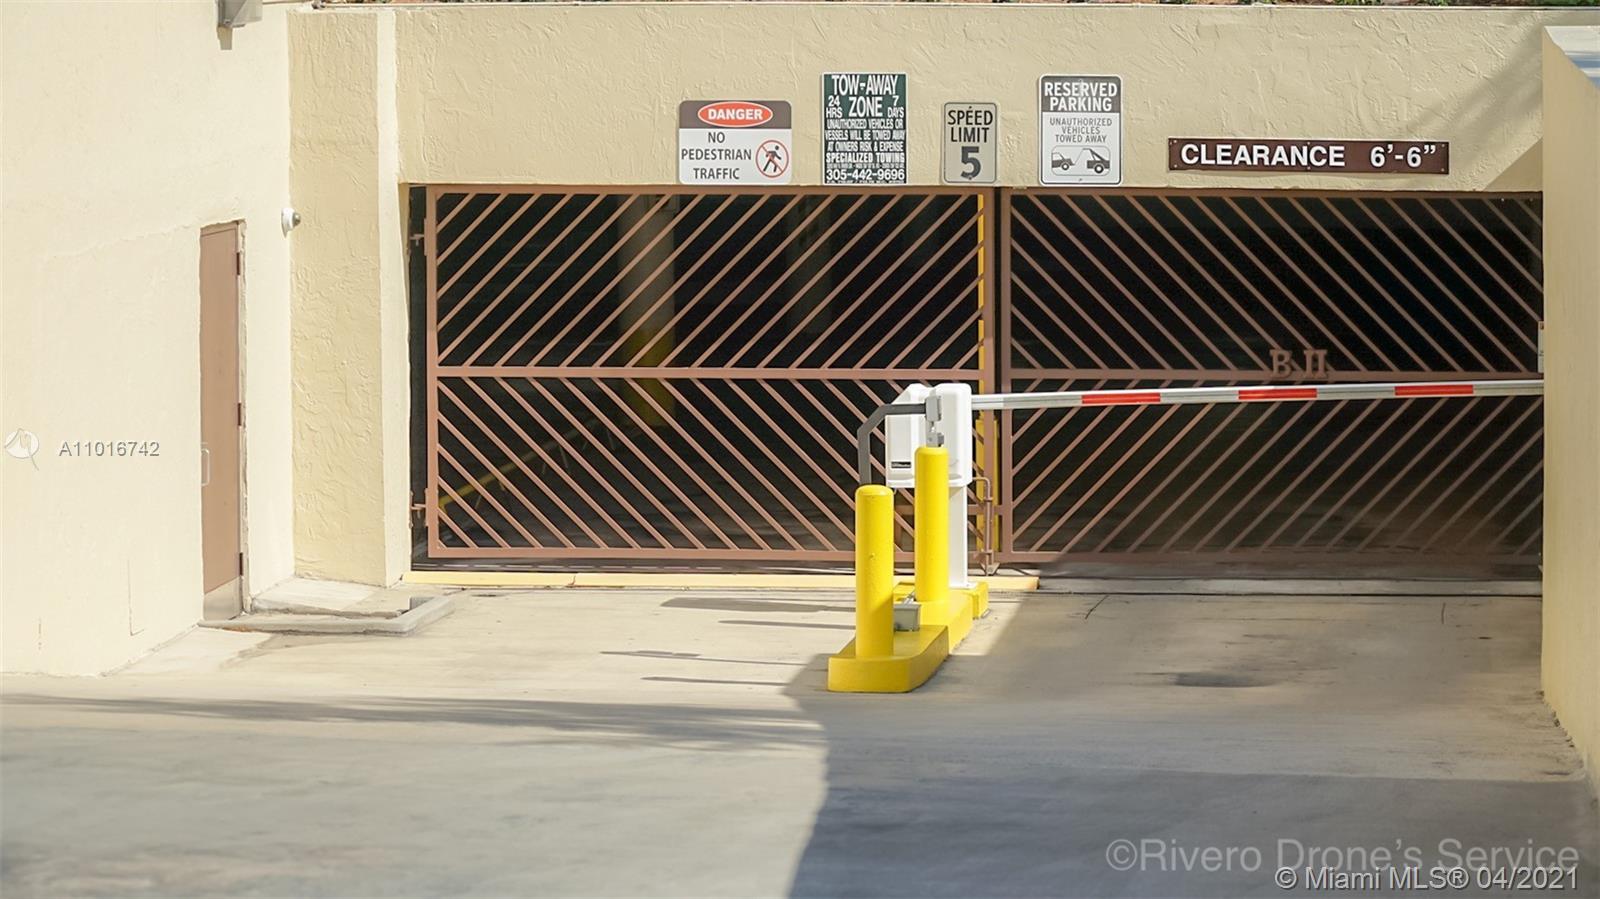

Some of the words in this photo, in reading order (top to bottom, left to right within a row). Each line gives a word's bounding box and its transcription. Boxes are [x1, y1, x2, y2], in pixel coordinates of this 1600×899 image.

[831, 74, 899, 96] TOW-AWAY
[1044, 82, 1118, 97] RESERVED
[828, 95, 841, 107] 24
[848, 96, 883, 118] ZONE
[892, 95, 900, 107] 7
[1049, 96, 1113, 112] PARKING
[707, 108, 763, 120] DANGER
[825, 106, 843, 119] HRS
[887, 106, 905, 119] DAYS
[947, 109, 994, 126] SPEED
[826, 118, 867, 130] UNAUTHORIZED
[868, 118, 894, 130] VEHICLES
[894, 118, 904, 130] OR
[1049, 117, 1113, 127] UNAUTHORIZED
[825, 129, 849, 141] VESSELS
[849, 129, 862, 141] WILL
[863, 129, 872, 141] BE
[872, 129, 891, 141] TOWED
[892, 129, 906, 141] AWAY
[950, 127, 990, 143] LIMIT
[1061, 126, 1101, 135] VEHICLES
[707, 131, 726, 144] NO
[1055, 134, 1083, 143] TOWED
[1085, 134, 1108, 143] AWAY
[827, 141, 834, 152] AT
[835, 141, 859, 152] OWNERS
[860, 141, 873, 152] RISK
[874, 141, 879, 152] &
[880, 141, 904, 152] EXPENSE
[681, 148, 752, 161] PEDESTRIAN
[826, 152, 874, 163] SPECIALIZED
[875, 152, 905, 163] TOWING
[1181, 143, 1346, 167] CLEARANCE
[961, 145, 982, 179] 5
[693, 167, 740, 180] TRAFFIC
[826, 168, 905, 181] 305-442-9696
